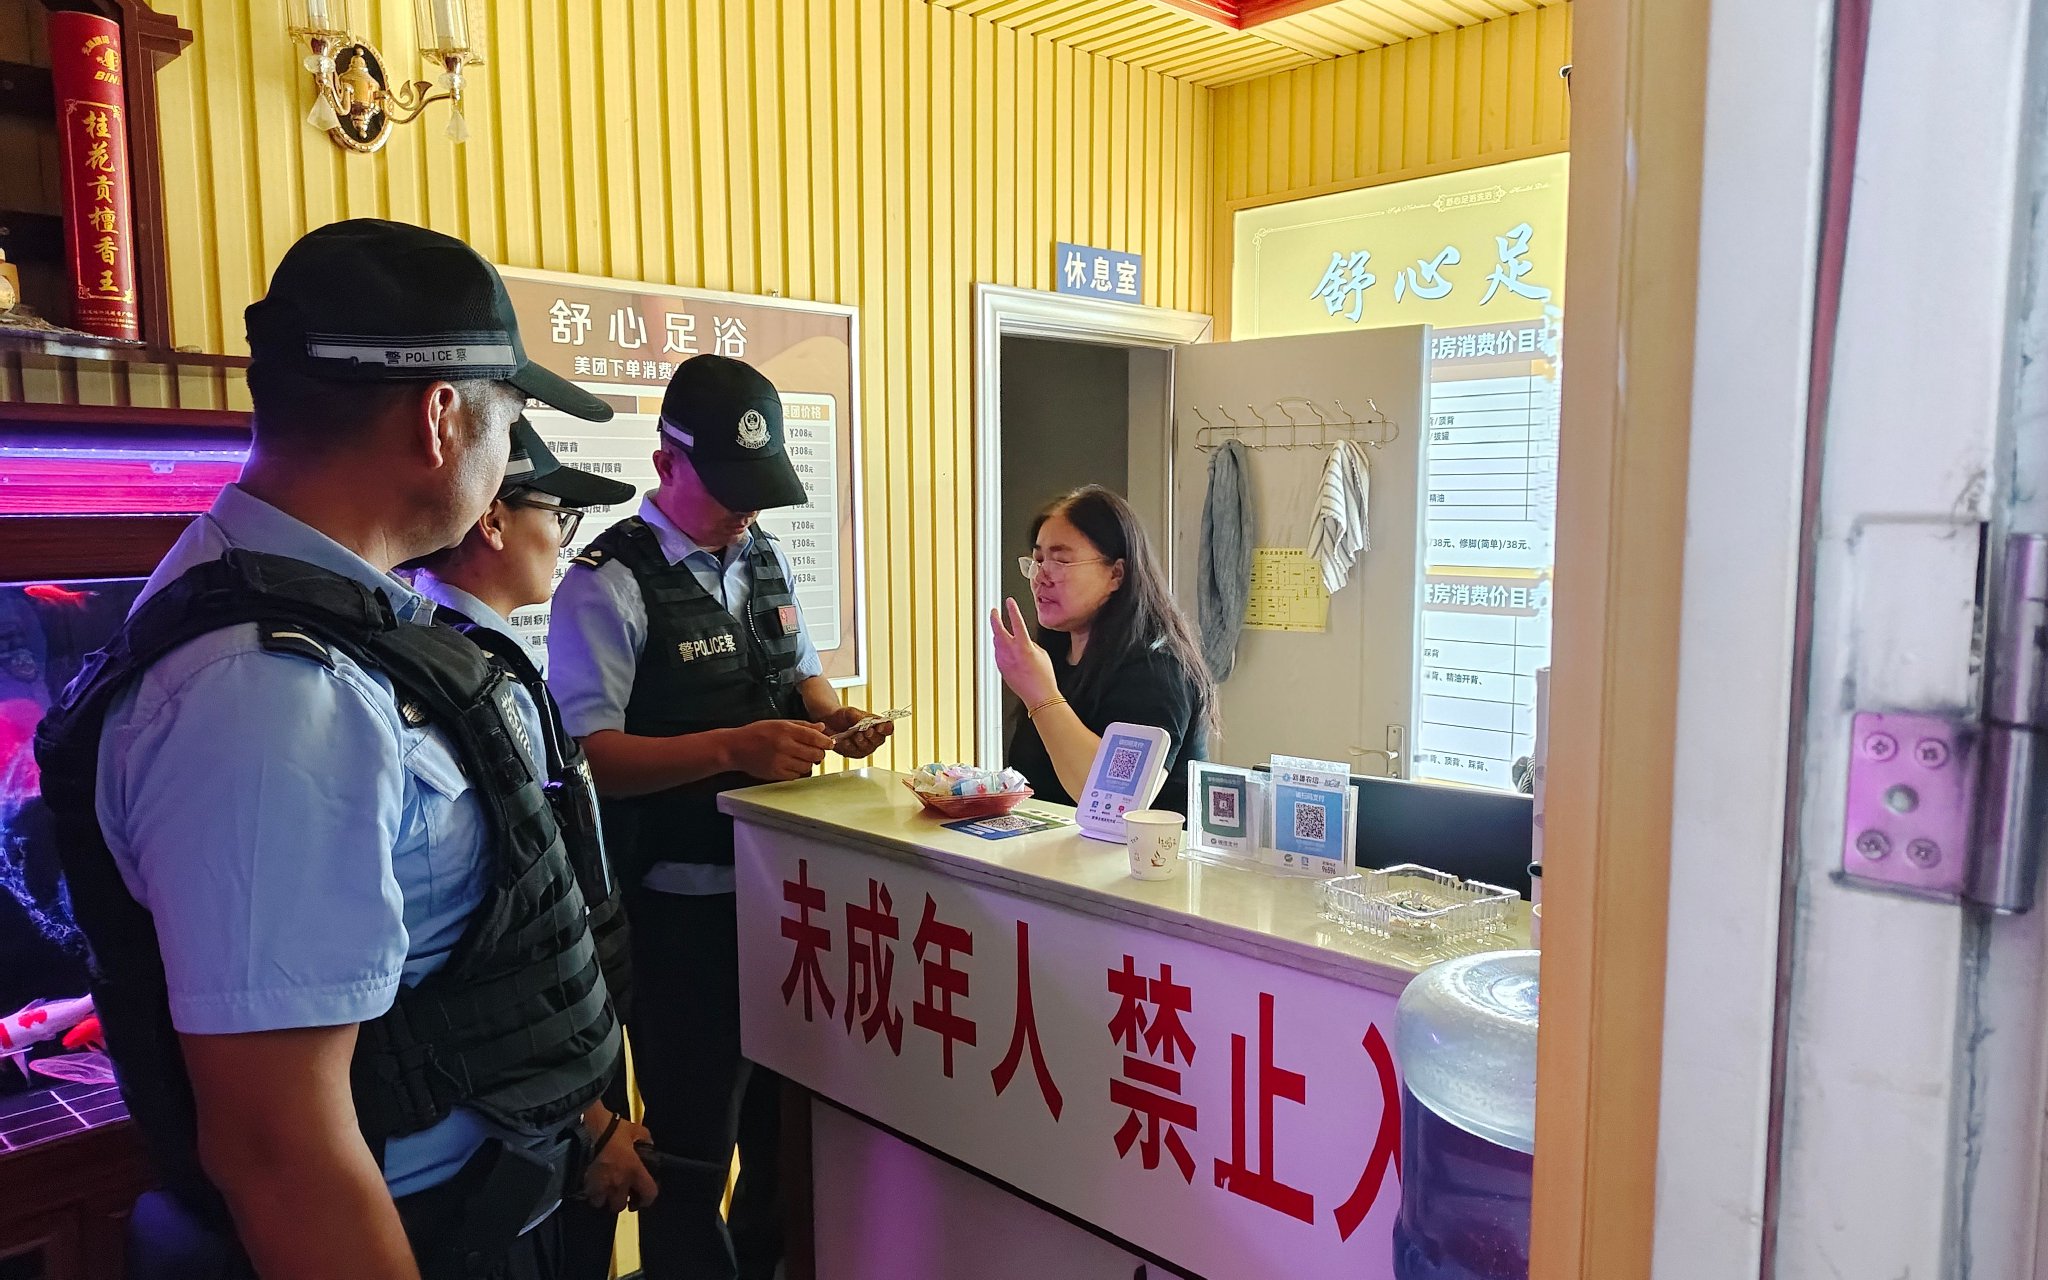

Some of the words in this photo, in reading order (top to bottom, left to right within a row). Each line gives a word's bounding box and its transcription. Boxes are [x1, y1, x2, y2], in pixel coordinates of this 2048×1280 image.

[82, 109, 120, 292] 桂花贡檀香王
[1064, 251, 1137, 296] 休息室
[549, 298, 748, 358] 舒心足浴
[405, 351, 452, 363] POLICE
[678, 634, 737, 662] 警POLICE察
[780, 859, 1063, 1122] 未成年人
